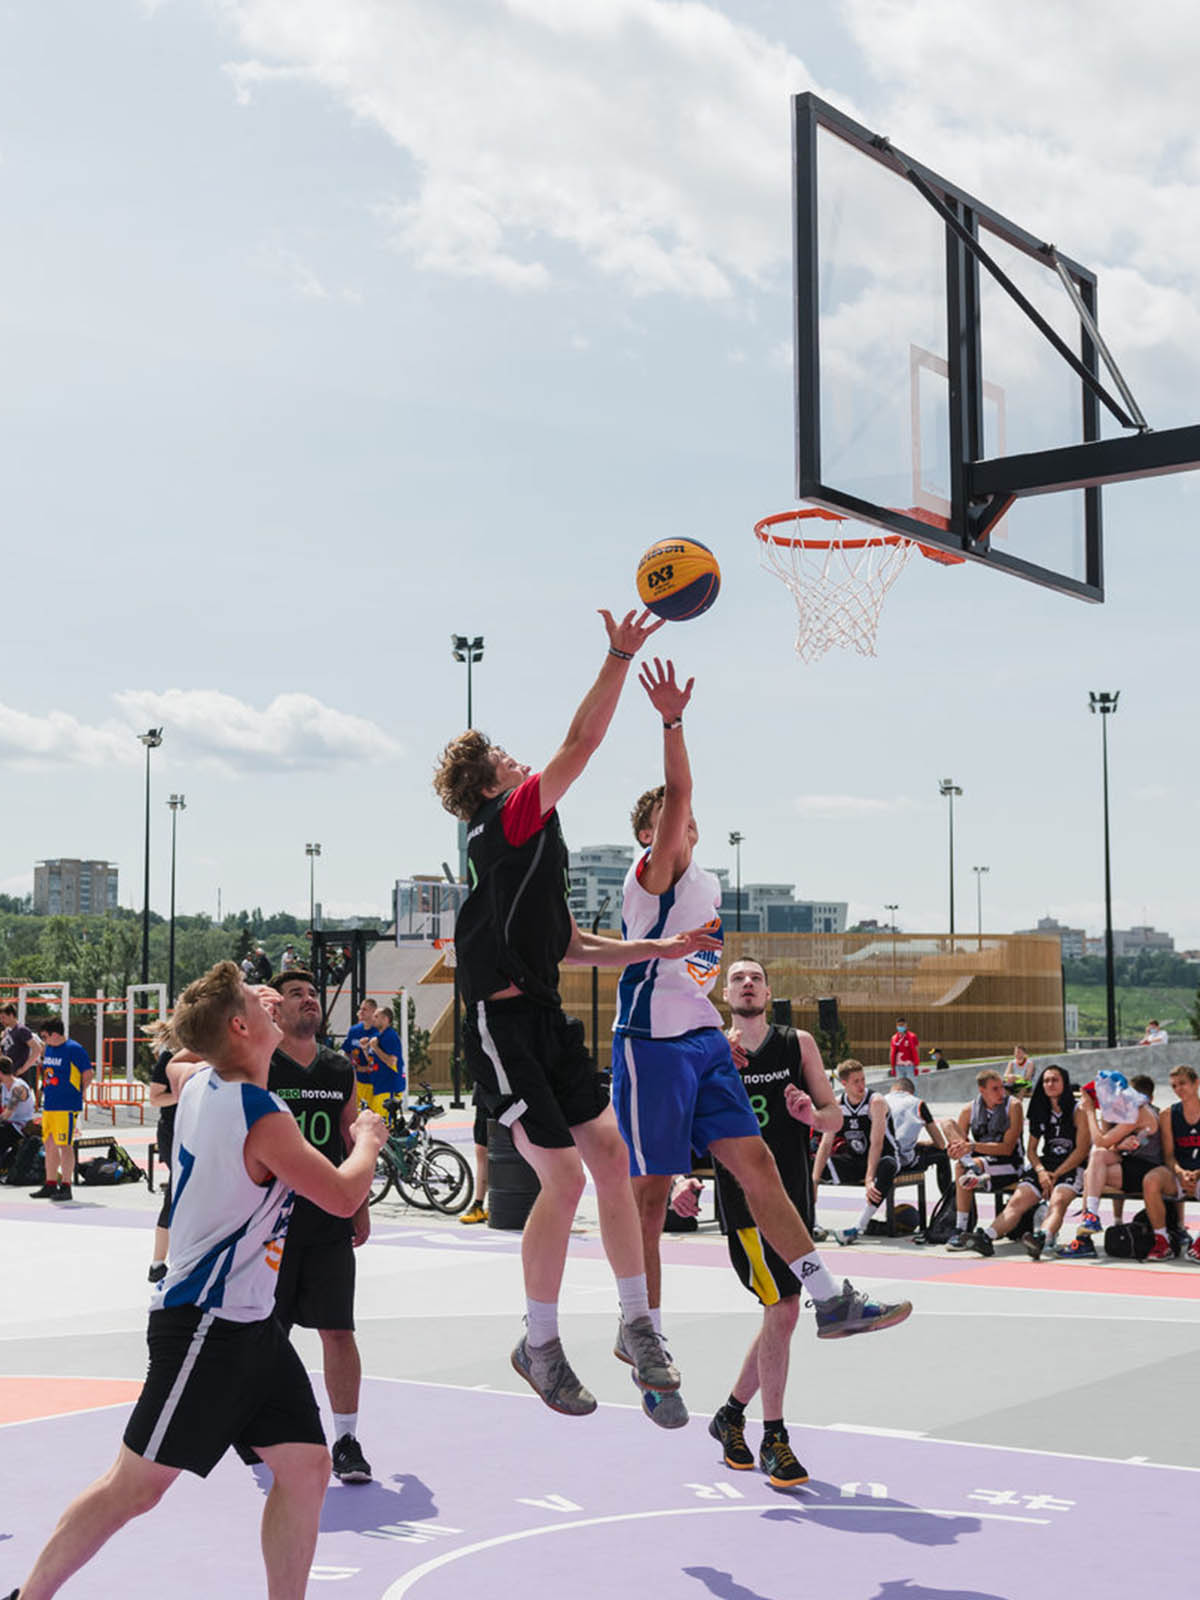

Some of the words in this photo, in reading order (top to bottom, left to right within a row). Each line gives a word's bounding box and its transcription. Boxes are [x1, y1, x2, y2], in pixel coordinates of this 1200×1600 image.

[743, 1067, 791, 1085] ПОТОЛКИ
[301, 1089, 344, 1099] ПОТОЛКИ
[750, 1094, 769, 1129] 8
[295, 1110, 332, 1145] 10
